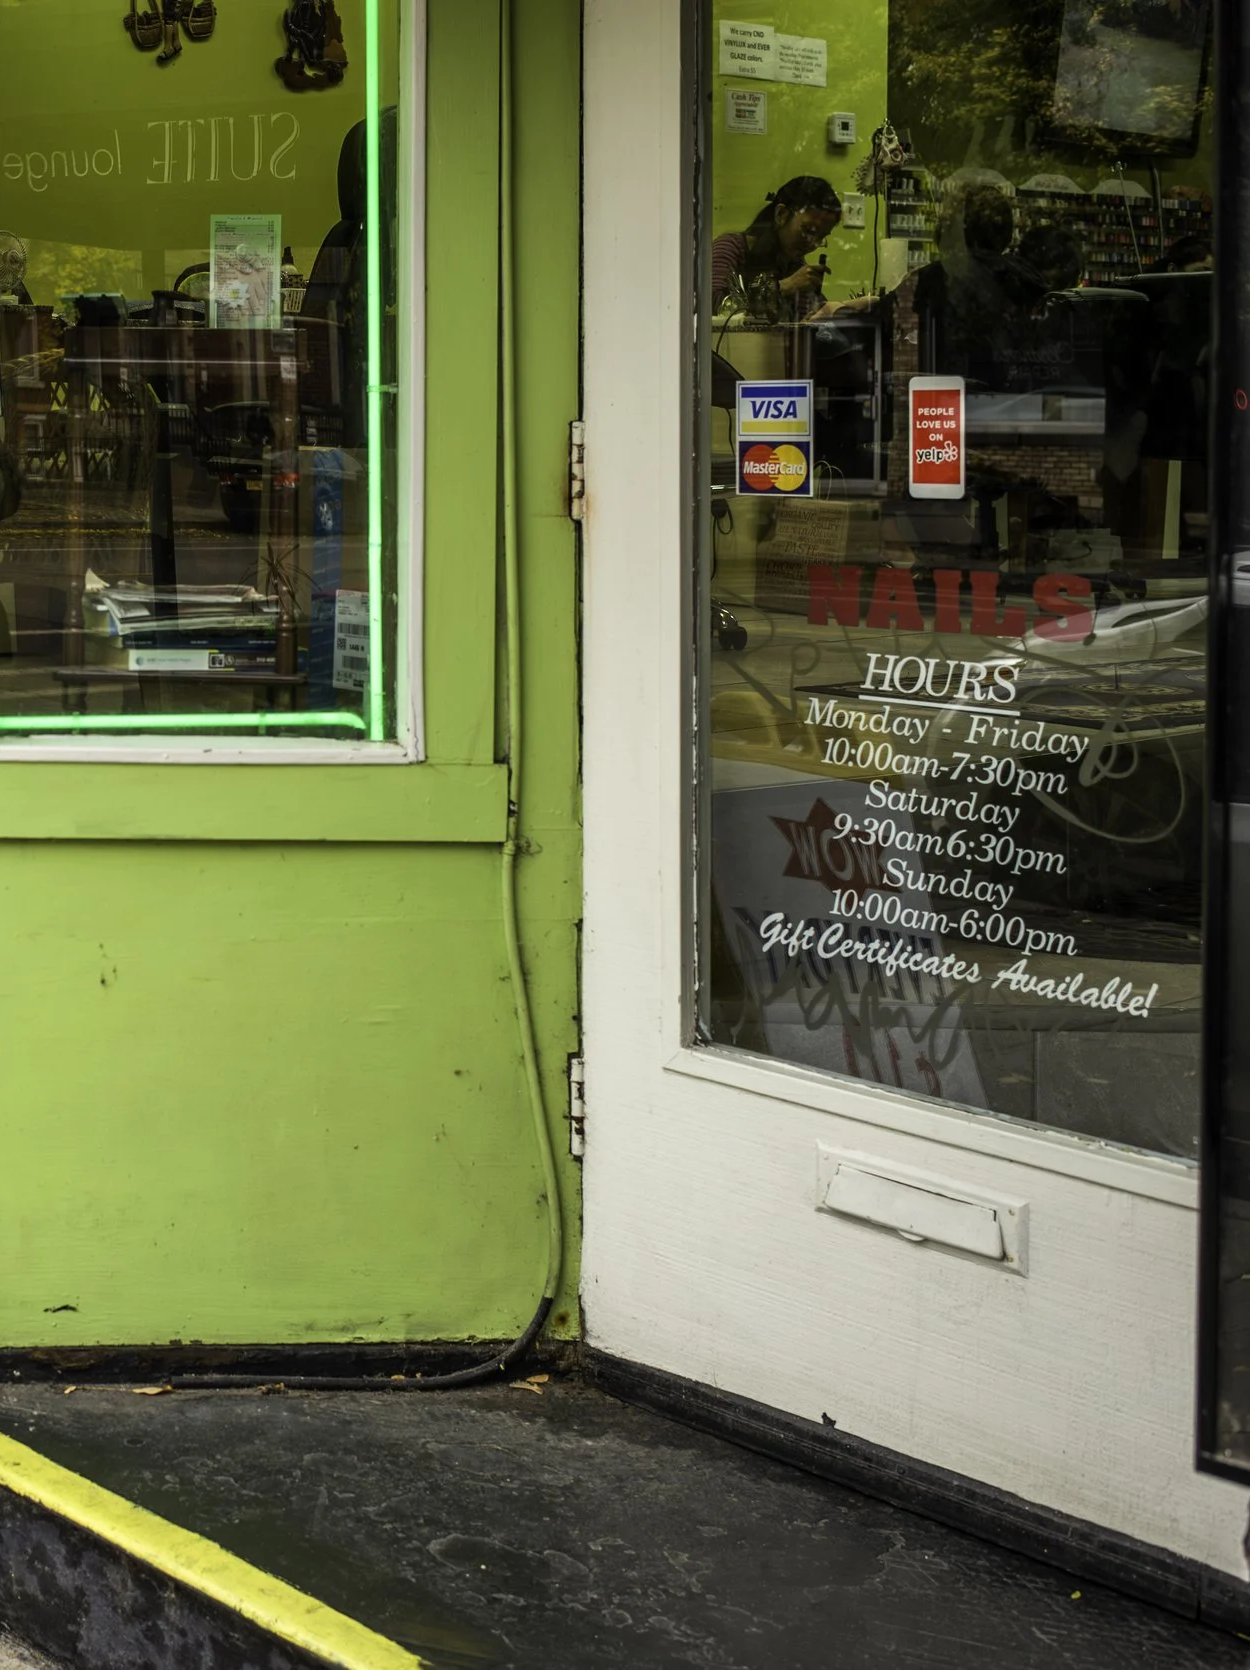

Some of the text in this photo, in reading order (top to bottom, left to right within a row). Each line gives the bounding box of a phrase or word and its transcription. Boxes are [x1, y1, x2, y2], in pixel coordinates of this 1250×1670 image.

[750, 400, 798, 419] VISA
[916, 420, 956, 429] LOVE US
[918, 407, 954, 416] PEOPLE
[916, 448, 944, 464] yelp
[928, 433, 943, 441] ON
[743, 460, 806, 476] MasterCard
[807, 565, 1092, 643] NAILS
[859, 652, 1020, 703] HOURS
[803, 697, 930, 744] Monday
[964, 715, 1089, 763] Friday
[821, 737, 1068, 797] 10:00am-7:30pm
[865, 779, 1020, 832] Saturday
[883, 858, 1015, 910] Sunday
[829, 888, 1078, 956] 10:00am-6:00pm
[760, 912, 814, 957] Gift
[816, 922, 982, 983] Certificates
[991, 958, 1159, 1018] Available!
